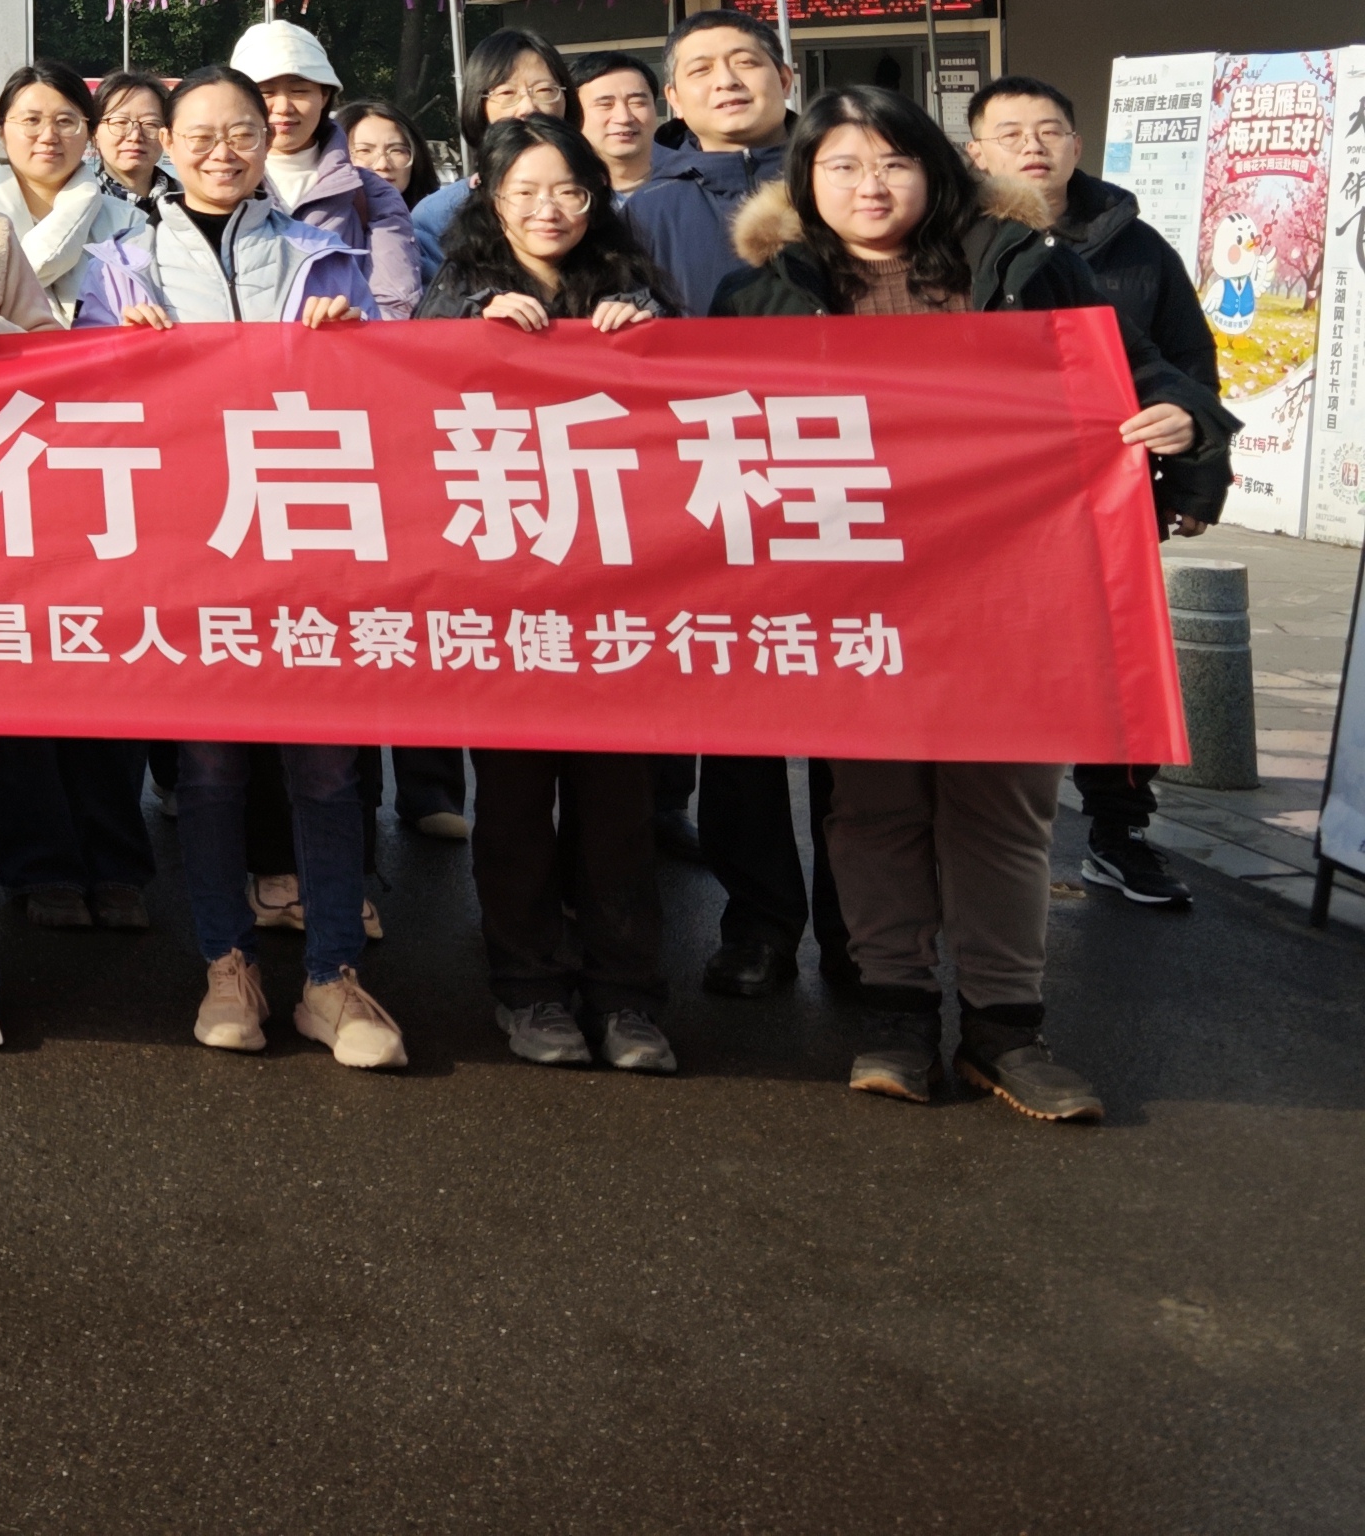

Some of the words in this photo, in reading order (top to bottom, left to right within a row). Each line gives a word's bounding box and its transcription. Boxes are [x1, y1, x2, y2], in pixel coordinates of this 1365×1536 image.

[1137, 118, 1199, 143] 票种公示
[1326, 269, 1348, 430] 东湖网红必打卡项目
